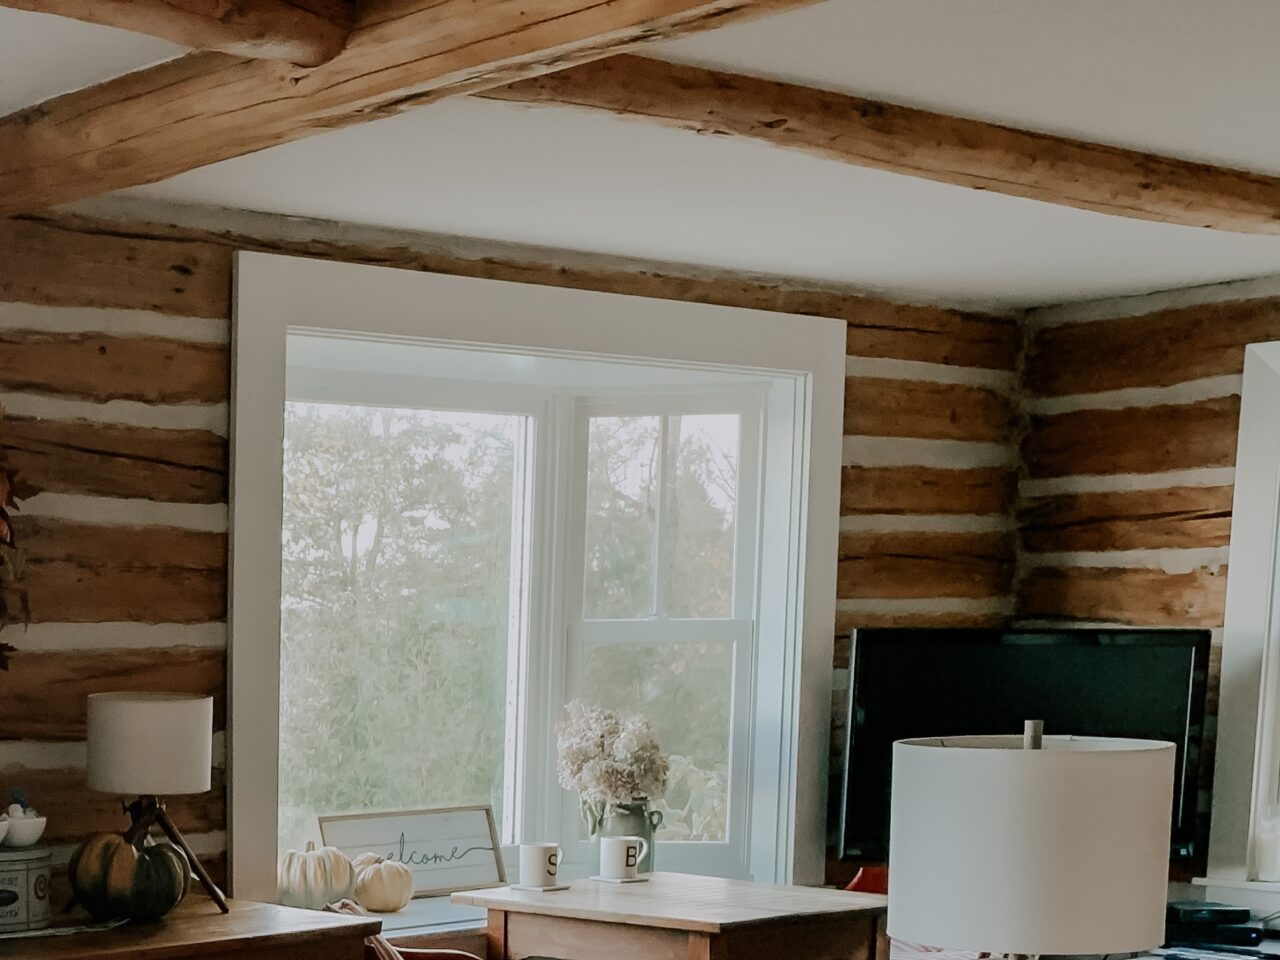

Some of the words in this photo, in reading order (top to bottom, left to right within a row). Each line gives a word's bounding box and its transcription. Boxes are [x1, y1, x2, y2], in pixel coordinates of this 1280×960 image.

[386, 831, 494, 865] elcome
[625, 846, 637, 867] B
[547, 853, 557, 876] S
